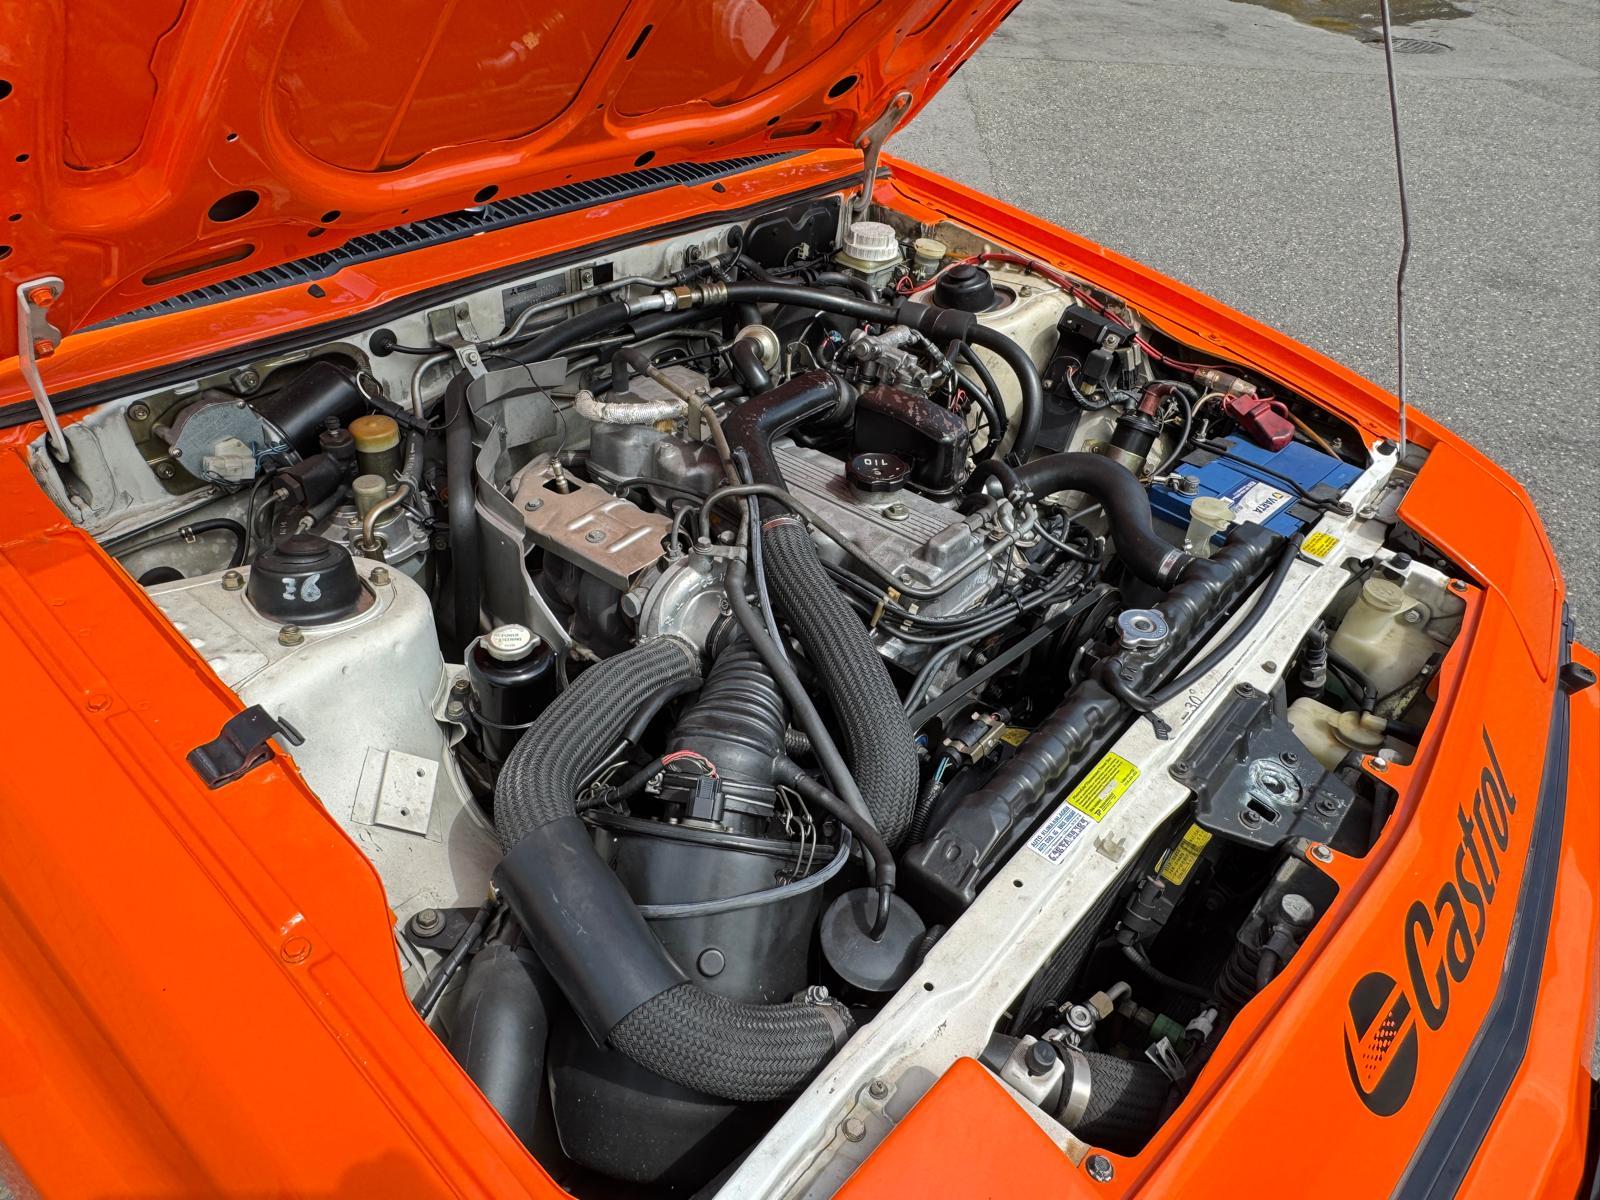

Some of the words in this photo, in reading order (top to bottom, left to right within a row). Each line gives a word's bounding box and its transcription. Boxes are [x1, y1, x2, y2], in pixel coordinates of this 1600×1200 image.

[864, 458, 888, 466] OIL
[1252, 497, 1278, 514] VARTA
[1030, 835, 1043, 848] AUTO
[1404, 723, 1517, 1031] Castrol
